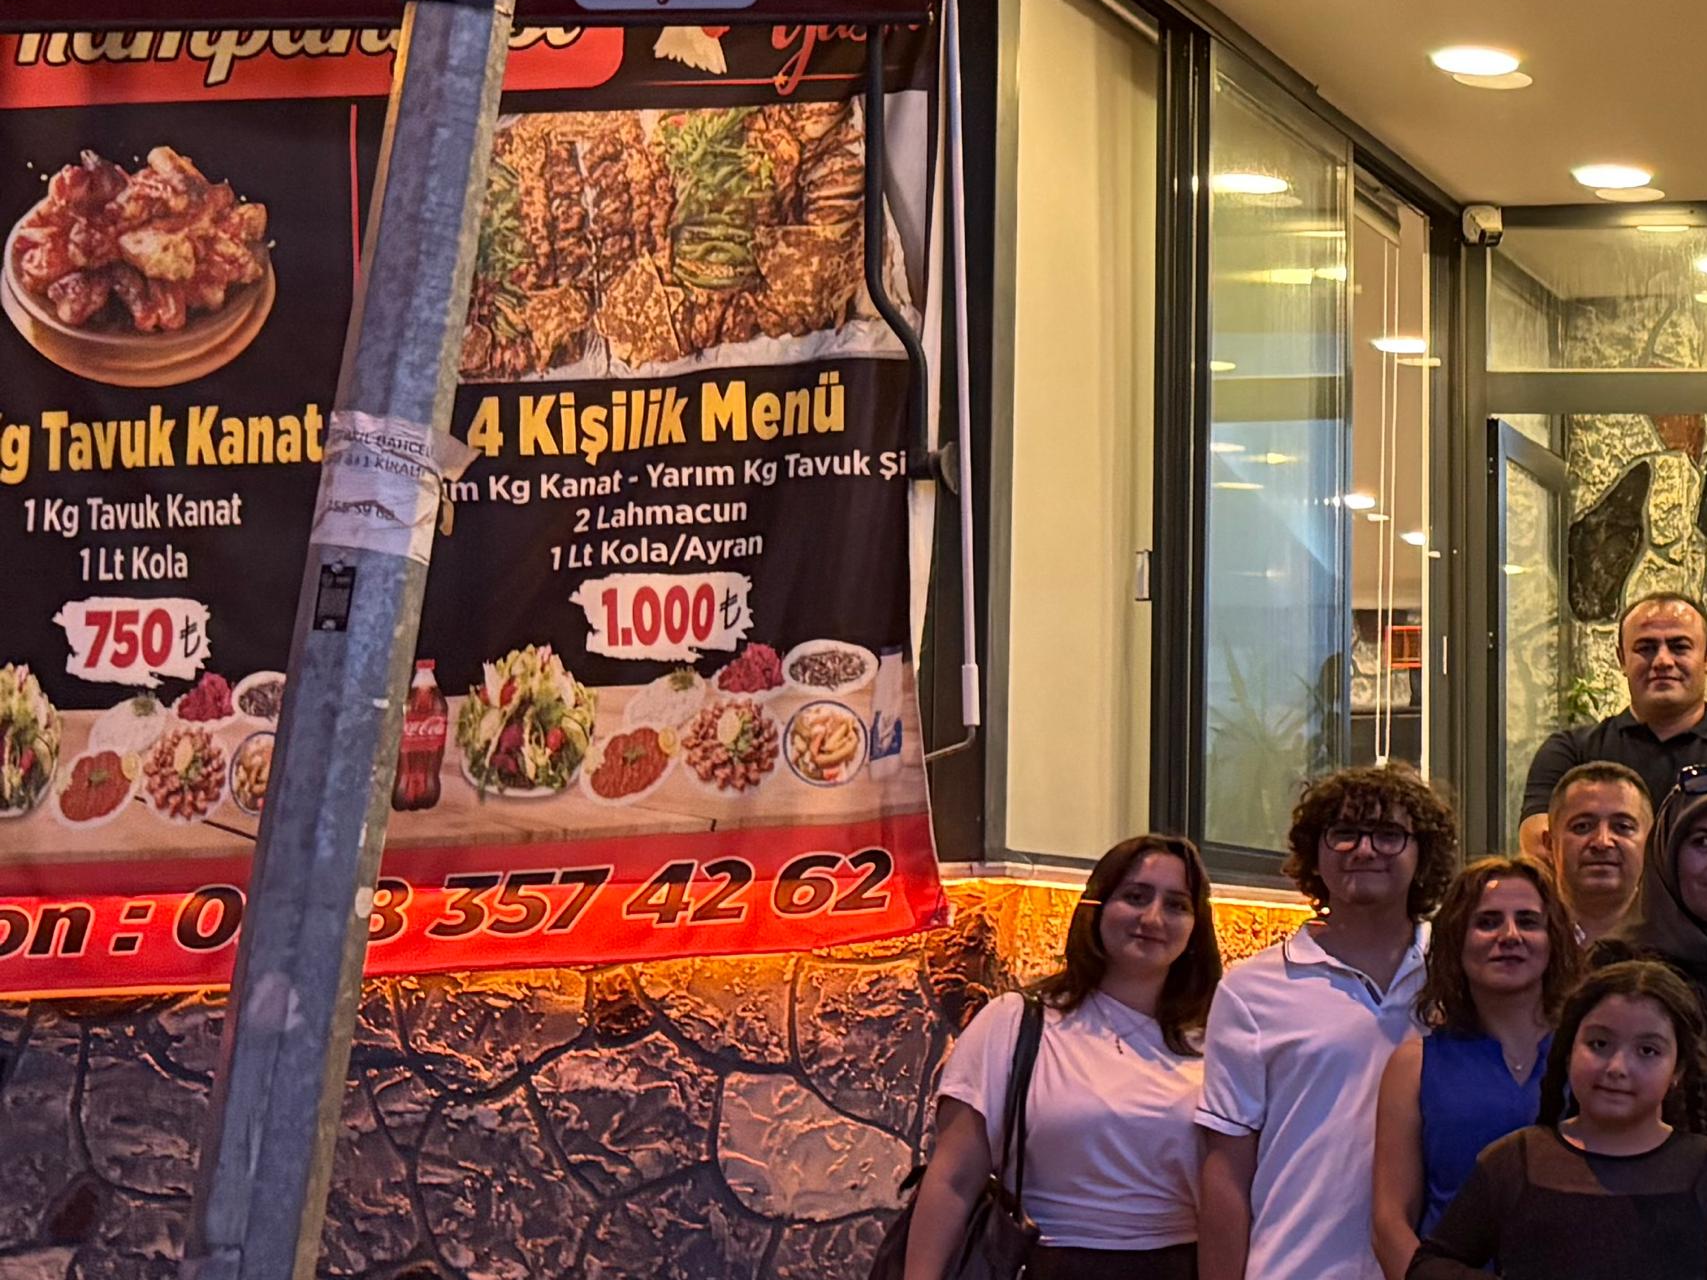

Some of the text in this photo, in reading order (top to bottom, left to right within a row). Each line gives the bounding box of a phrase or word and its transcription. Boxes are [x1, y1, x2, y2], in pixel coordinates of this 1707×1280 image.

[467, 371, 846, 466] 4 Kişilik Menü
[0, 402, 324, 485] g Tavuk Kanat
[489, 474, 530, 504] Kg
[540, 469, 622, 500] Kanat
[646, 463, 734, 490] Yarım
[744, 459, 777, 487] Kg
[785, 450, 870, 479] Tavuk
[879, 451, 907, 482] Şi
[25, 493, 242, 538] 1 Kg Tavuk Kanat
[574, 500, 748, 533] 2 Lahmacun
[80, 543, 189, 581] 1 Lt Kola
[551, 533, 764, 571] 1 Lt Kola/Ayran
[424, 864, 613, 941] 357
[621, 856, 755, 928] 42
[769, 847, 894, 920] 62
